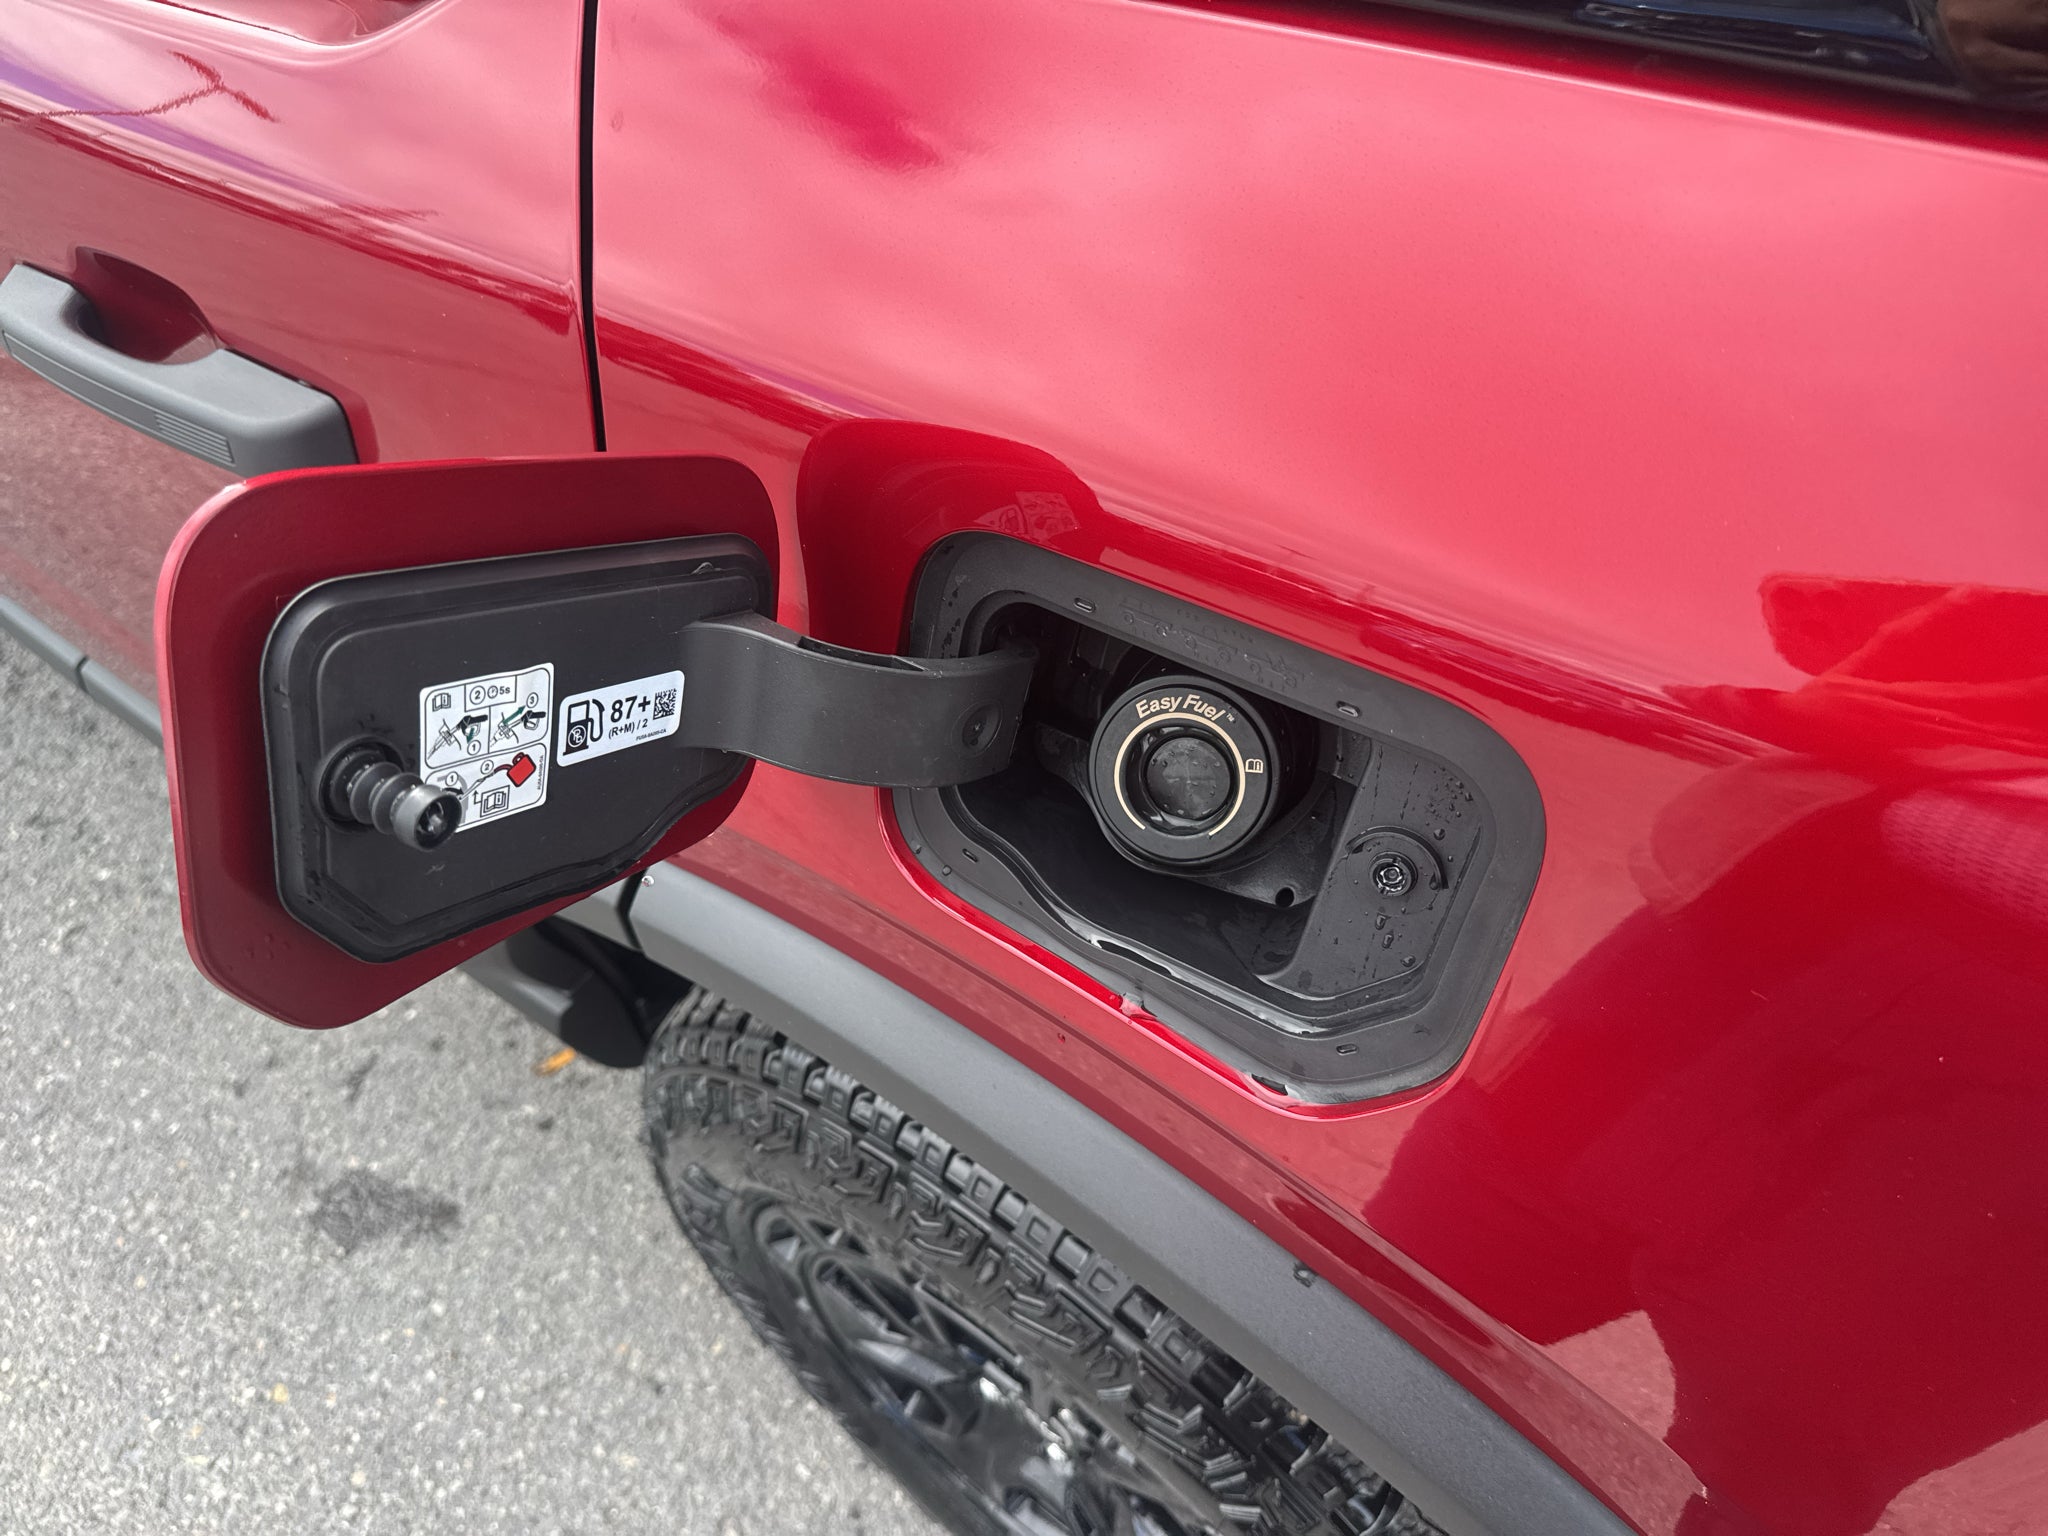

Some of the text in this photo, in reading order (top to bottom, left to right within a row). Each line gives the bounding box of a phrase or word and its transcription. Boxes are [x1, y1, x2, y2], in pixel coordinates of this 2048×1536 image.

[499, 686, 511, 696] 5s
[610, 695, 651, 723] 87+
[1135, 696, 1183, 719] Easy
[1182, 694, 1226, 721] Fuel
